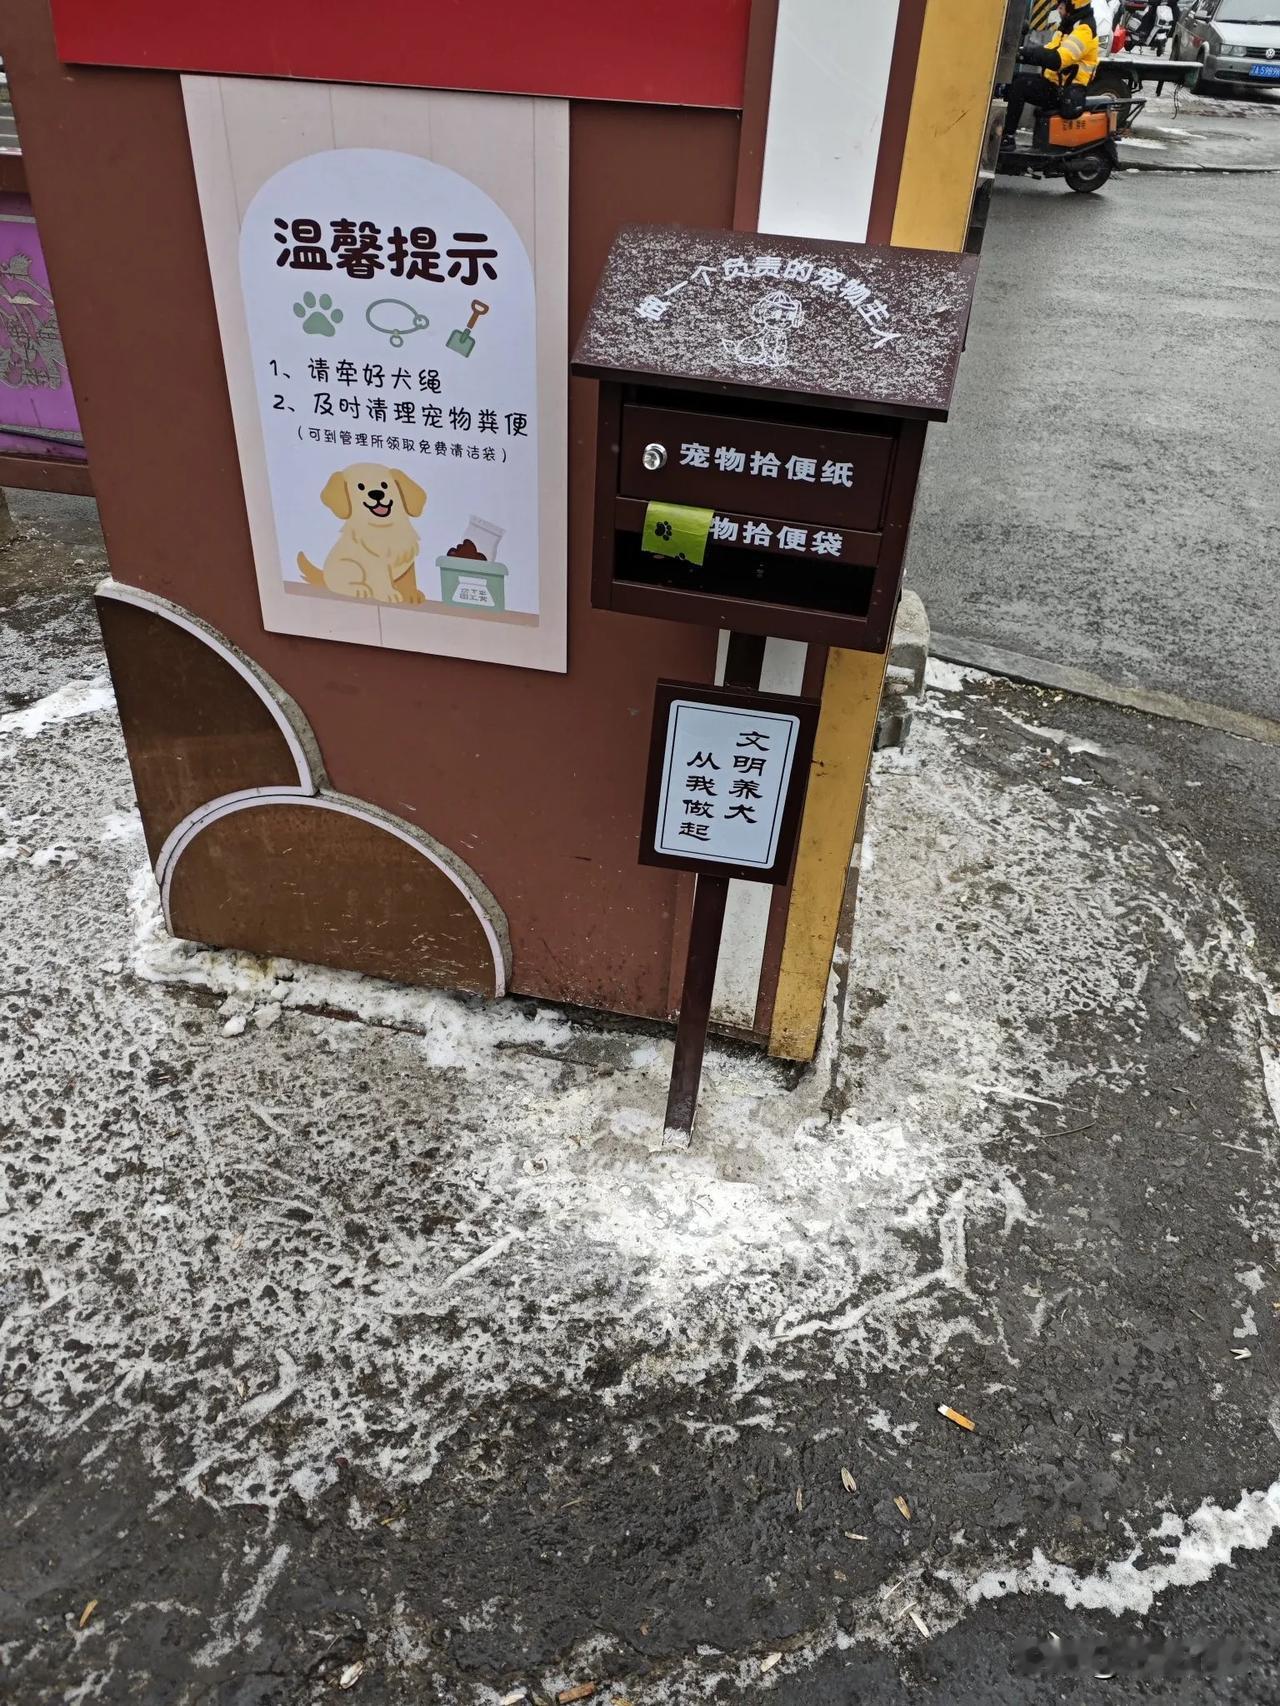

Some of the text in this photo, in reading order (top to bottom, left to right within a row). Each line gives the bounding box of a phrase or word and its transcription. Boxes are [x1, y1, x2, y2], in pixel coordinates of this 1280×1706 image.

[274, 217, 498, 286] 温馨提示
[269, 357, 443, 395] 1、请牵好犬绳
[272, 392, 529, 438] 2、及时清理宠物粪便
[297, 424, 508, 464] （可到管理所领取免费清洁袋）
[679, 441, 855, 489] 宠物拾便纸
[710, 515, 844, 558] 物拾便袋
[678, 750, 721, 842] 从我做起
[723, 730, 771, 825] 文明养犬
